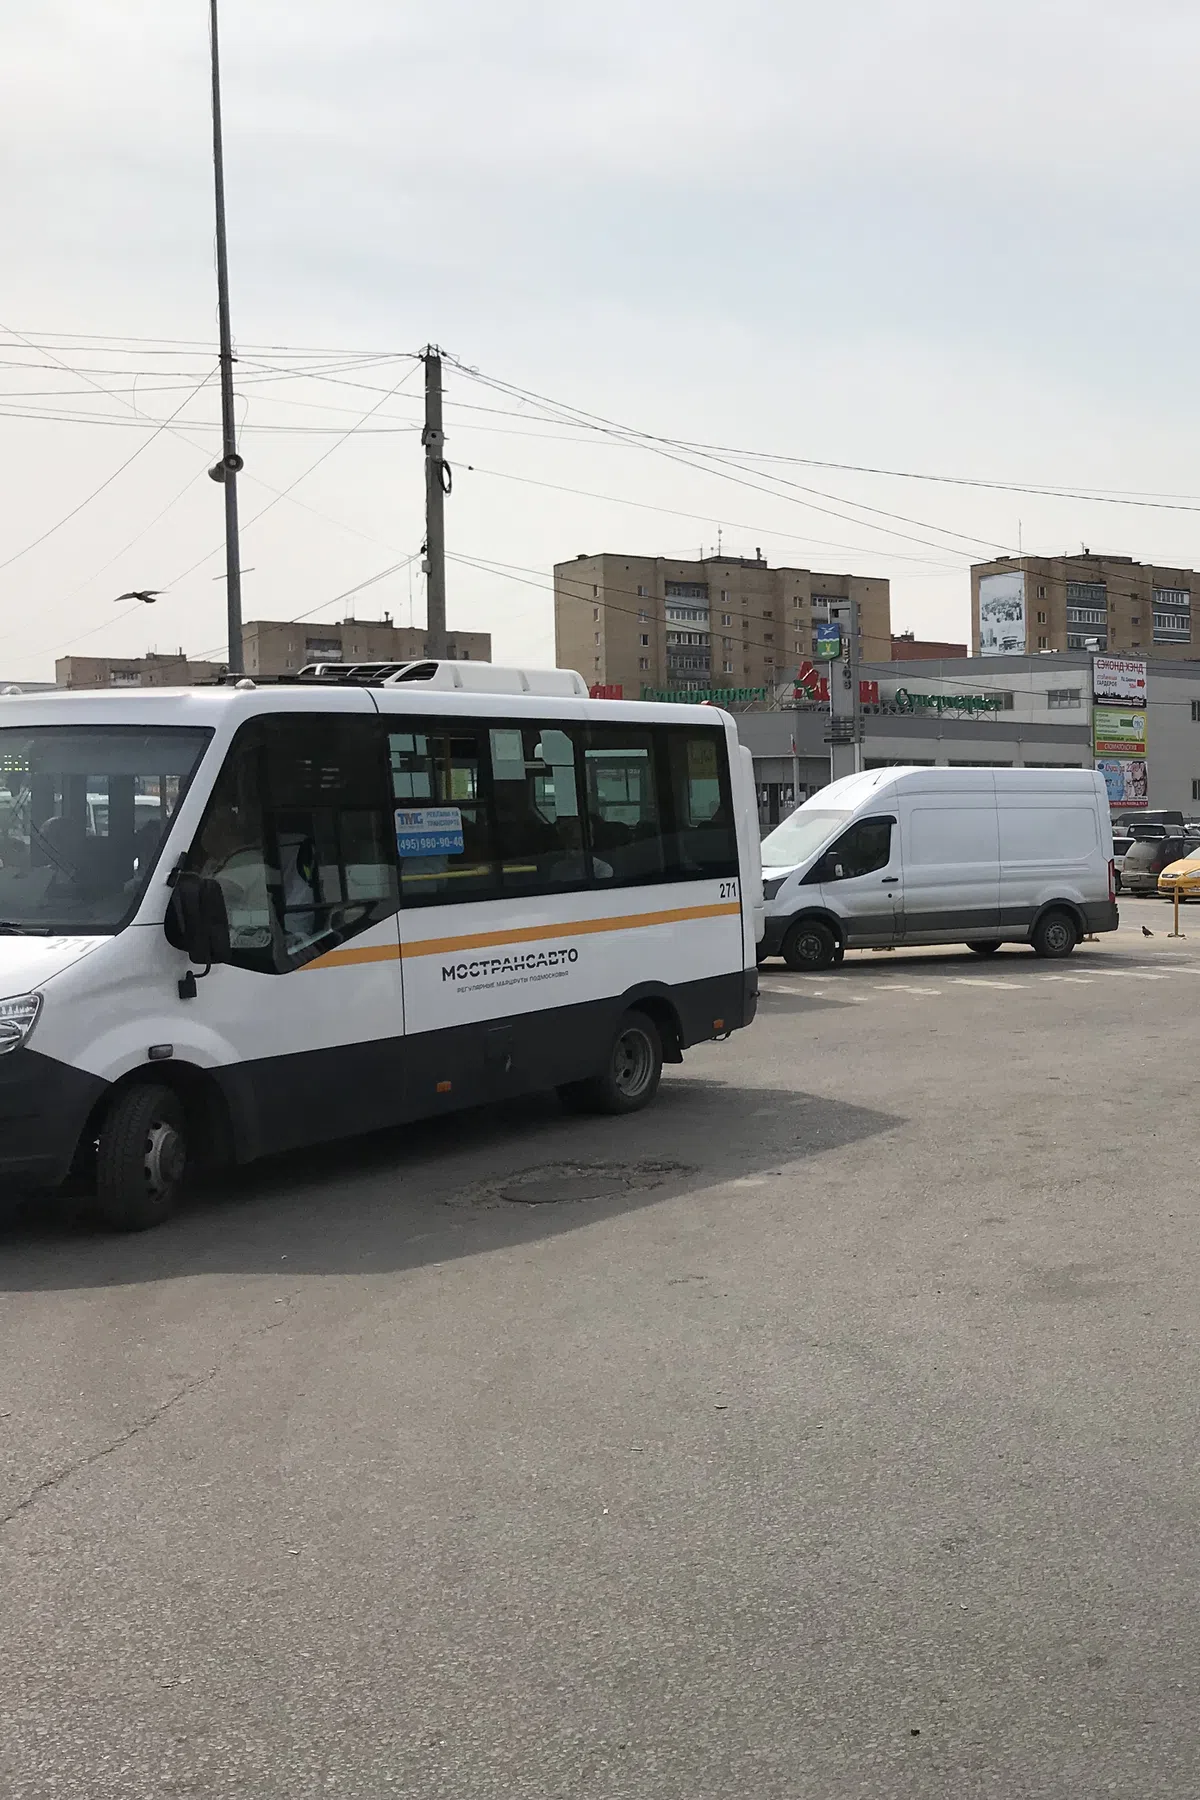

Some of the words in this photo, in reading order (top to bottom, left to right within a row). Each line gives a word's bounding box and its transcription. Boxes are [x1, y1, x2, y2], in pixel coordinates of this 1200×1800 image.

[1096, 659, 1124, 673] СЭКОНД
[1125, 662, 1144, 675] ХЭНД
[644, 687, 767, 707] Супермаркет
[895, 687, 1003, 714] Супермаркет
[398, 838, 420, 852] (495)
[420, 836, 464, 849] 980-90-40
[719, 882, 737, 899] 271
[46, 937, 96, 953] 271
[442, 948, 579, 982] МОСТРАНСАВТО
[457, 982, 495, 994] РЕГУЛЯРНЫЕ
[496, 977, 529, 988] МАРШРУТЫ
[529, 970, 569, 982] ПОДМОСКОВЬЯ
